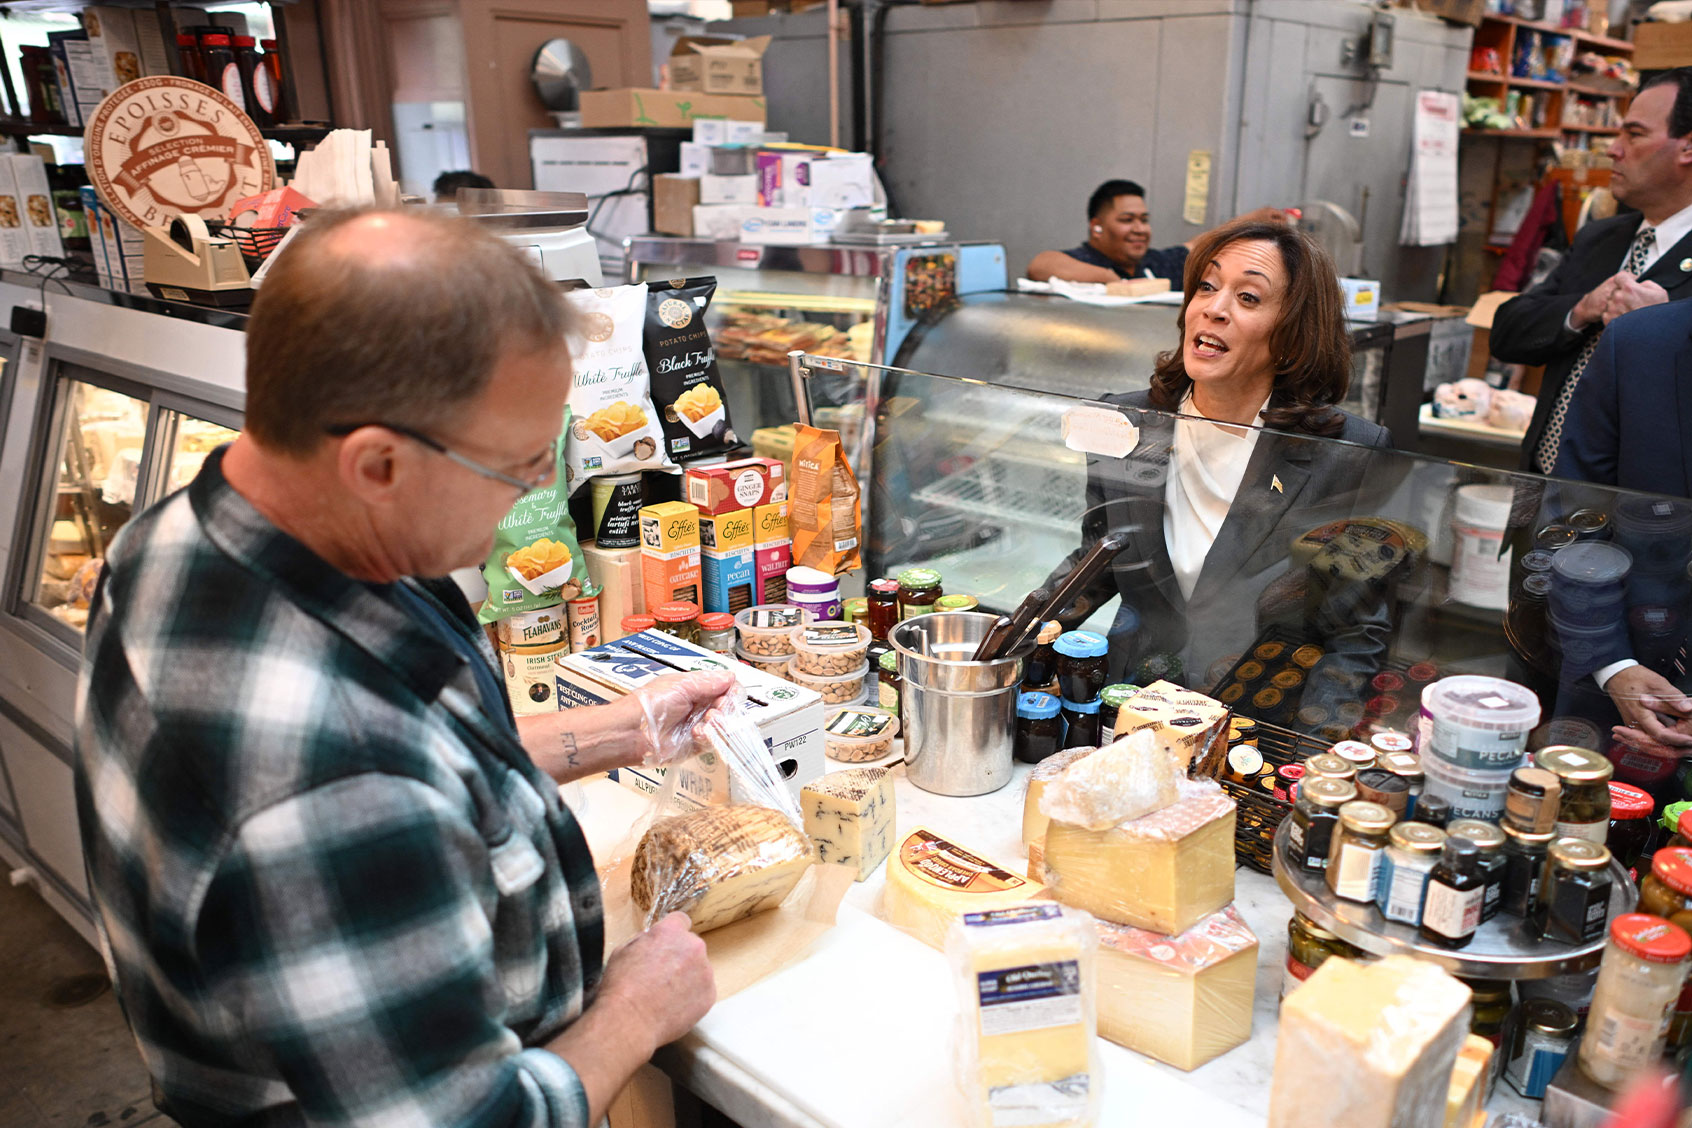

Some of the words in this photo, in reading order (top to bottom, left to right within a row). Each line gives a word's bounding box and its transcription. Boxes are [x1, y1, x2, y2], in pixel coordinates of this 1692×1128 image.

[108, 91, 225, 146] EPOISSES
[131, 148, 181, 177] AFFINAGE
[659, 335, 687, 348] POTATO
[656, 353, 693, 374] Black
[573, 370, 608, 388] White
[608, 361, 643, 384] Truffle
[685, 370, 705, 380] PREMIUM
[737, 482, 762, 493] GINGER
[739, 490, 760, 499] SNAPS
[514, 489, 557, 509] osemary
[498, 509, 535, 531] White
[534, 500, 569, 526] Truffle
[667, 519, 696, 541] Effie's
[722, 520, 751, 541] Effie's
[762, 538, 788, 549] BISCUITS
[669, 547, 697, 559] BISCUITS
[724, 547, 750, 558] BISCUITS
[572, 612, 598, 628] Cocktail
[526, 655, 546, 665] IRISH
[570, 690, 589, 703] CLING
[784, 735, 808, 752] PW122
[680, 768, 713, 801] WRAP
[1448, 804, 1500, 818] ECANS
[919, 859, 970, 883] APPLEWOOD
